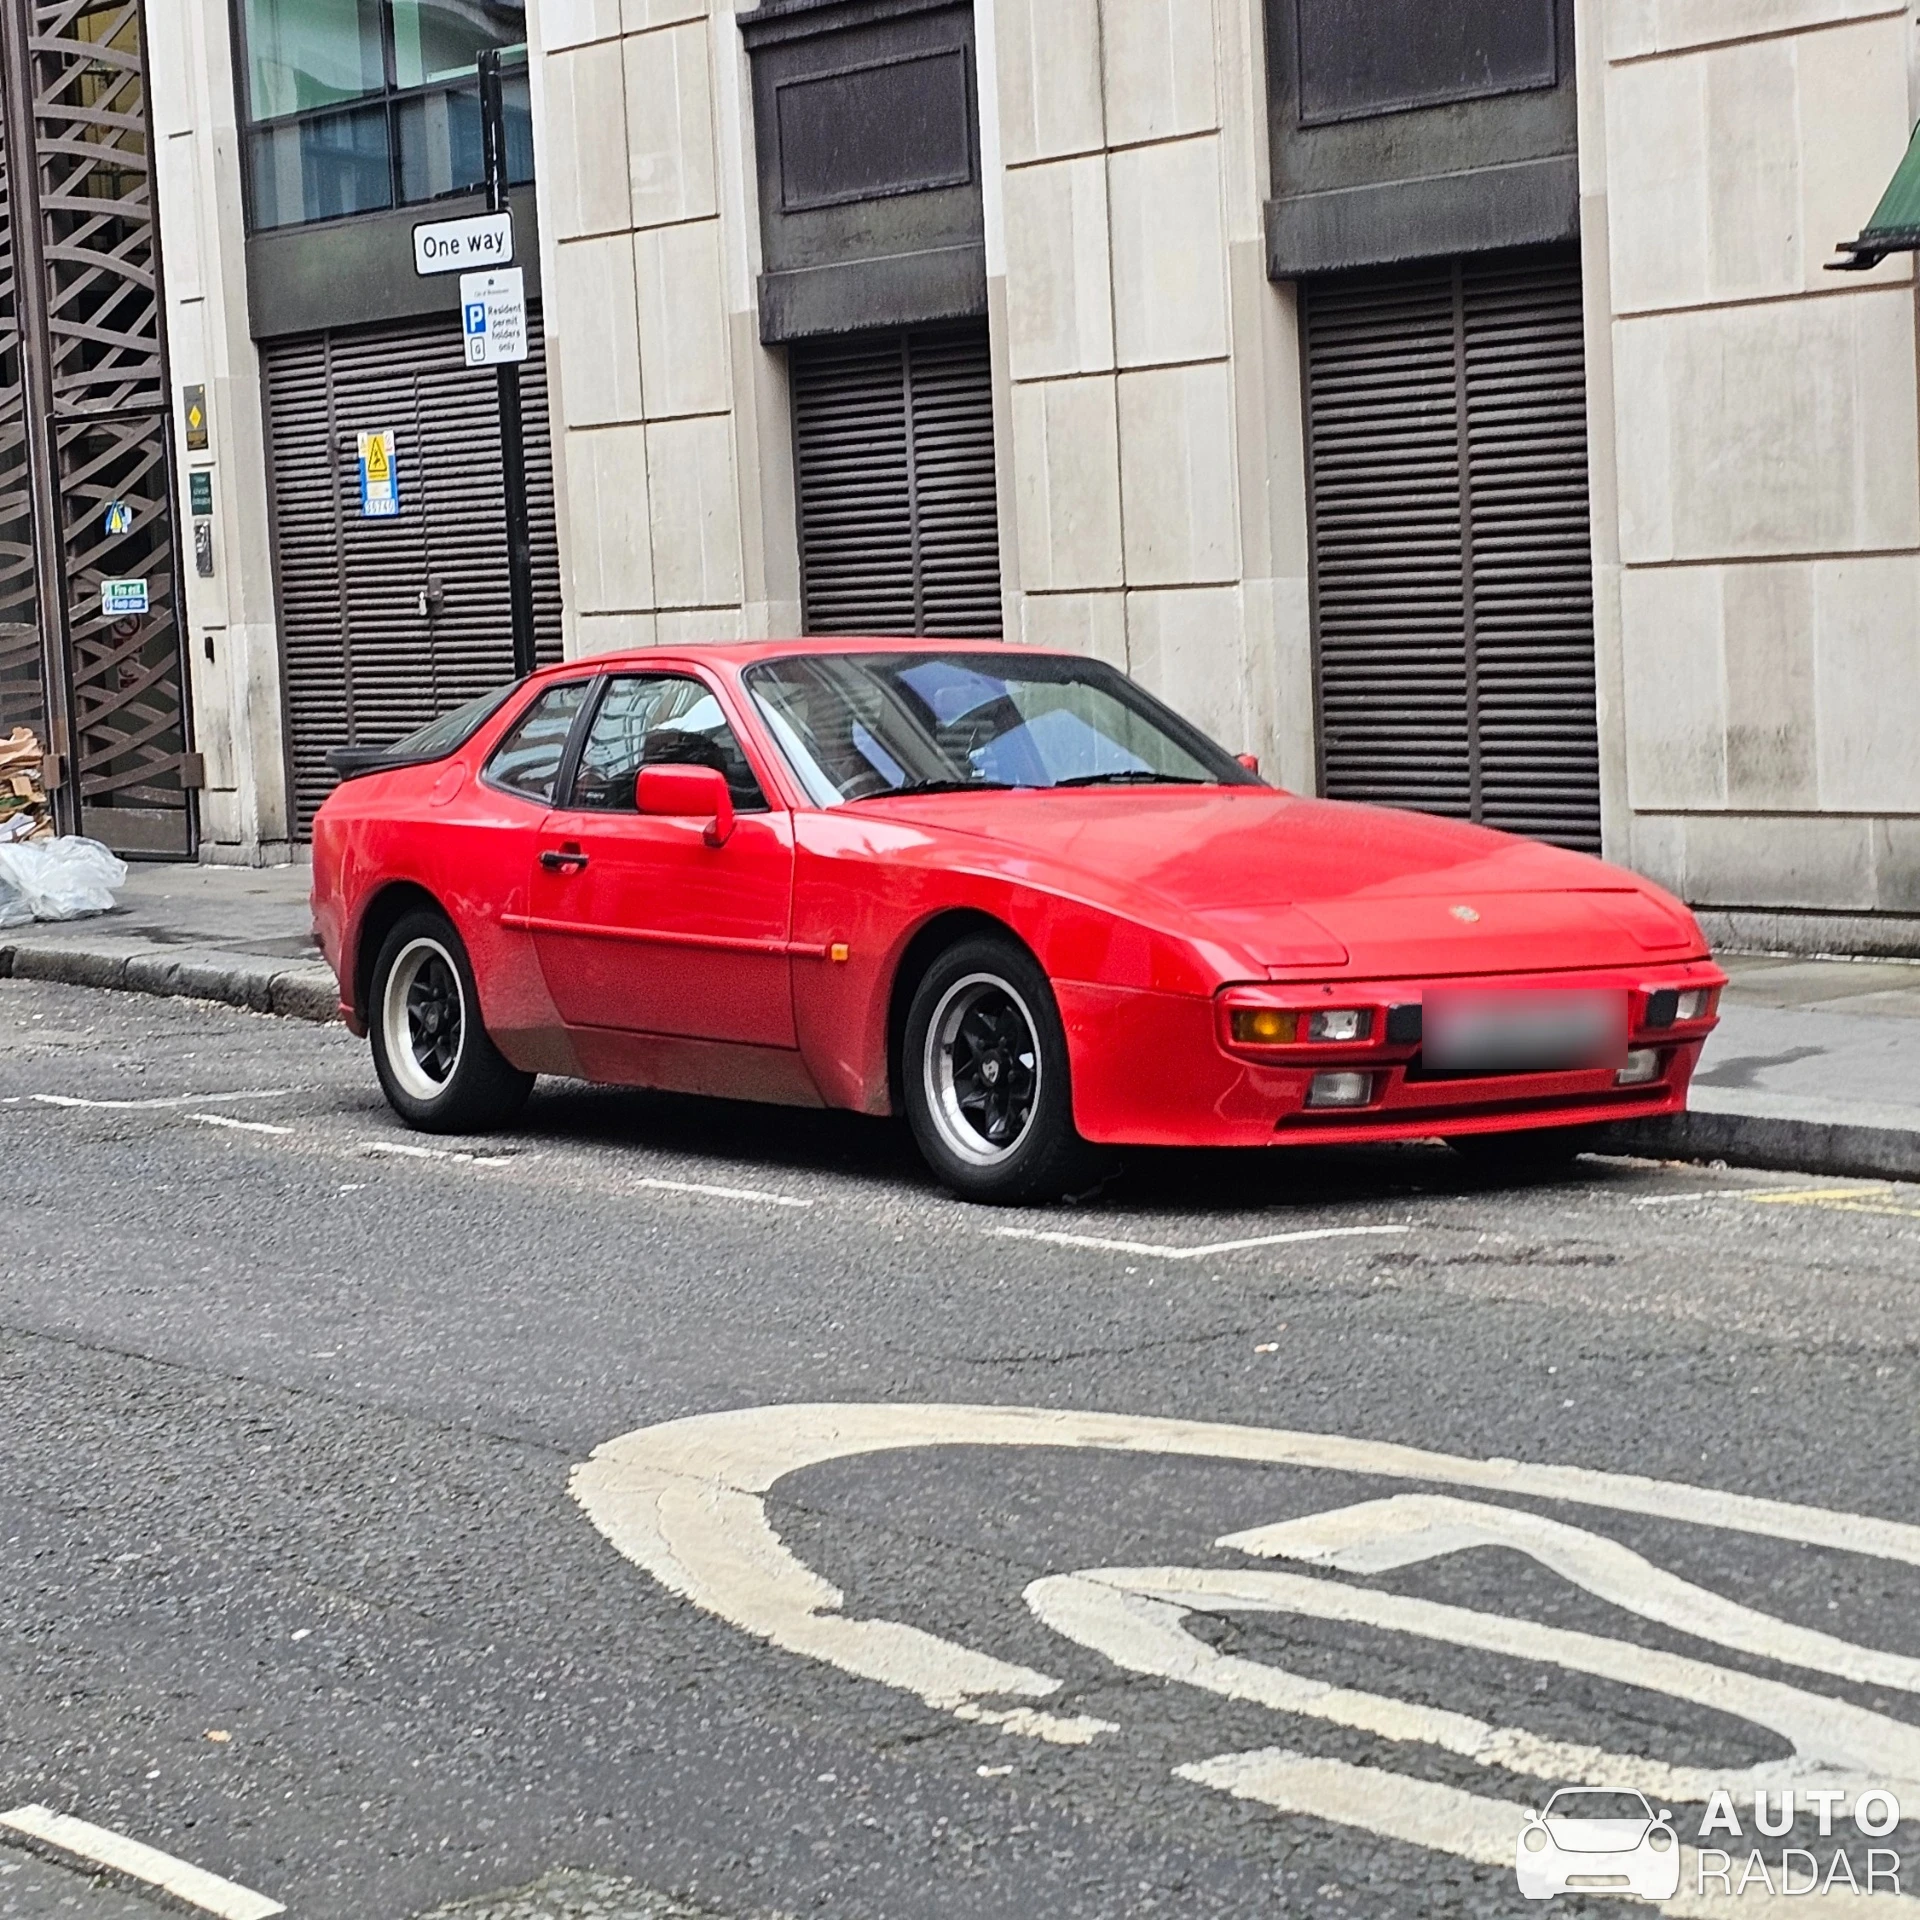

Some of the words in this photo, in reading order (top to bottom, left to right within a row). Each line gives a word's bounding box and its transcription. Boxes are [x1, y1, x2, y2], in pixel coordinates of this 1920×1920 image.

[423, 236, 460, 258] One
[467, 231, 504, 254] way
[488, 303, 521, 316] Resident
[469, 305, 484, 332] P
[492, 316, 518, 328] permit
[491, 330, 521, 340] holders
[498, 342, 516, 352] only
